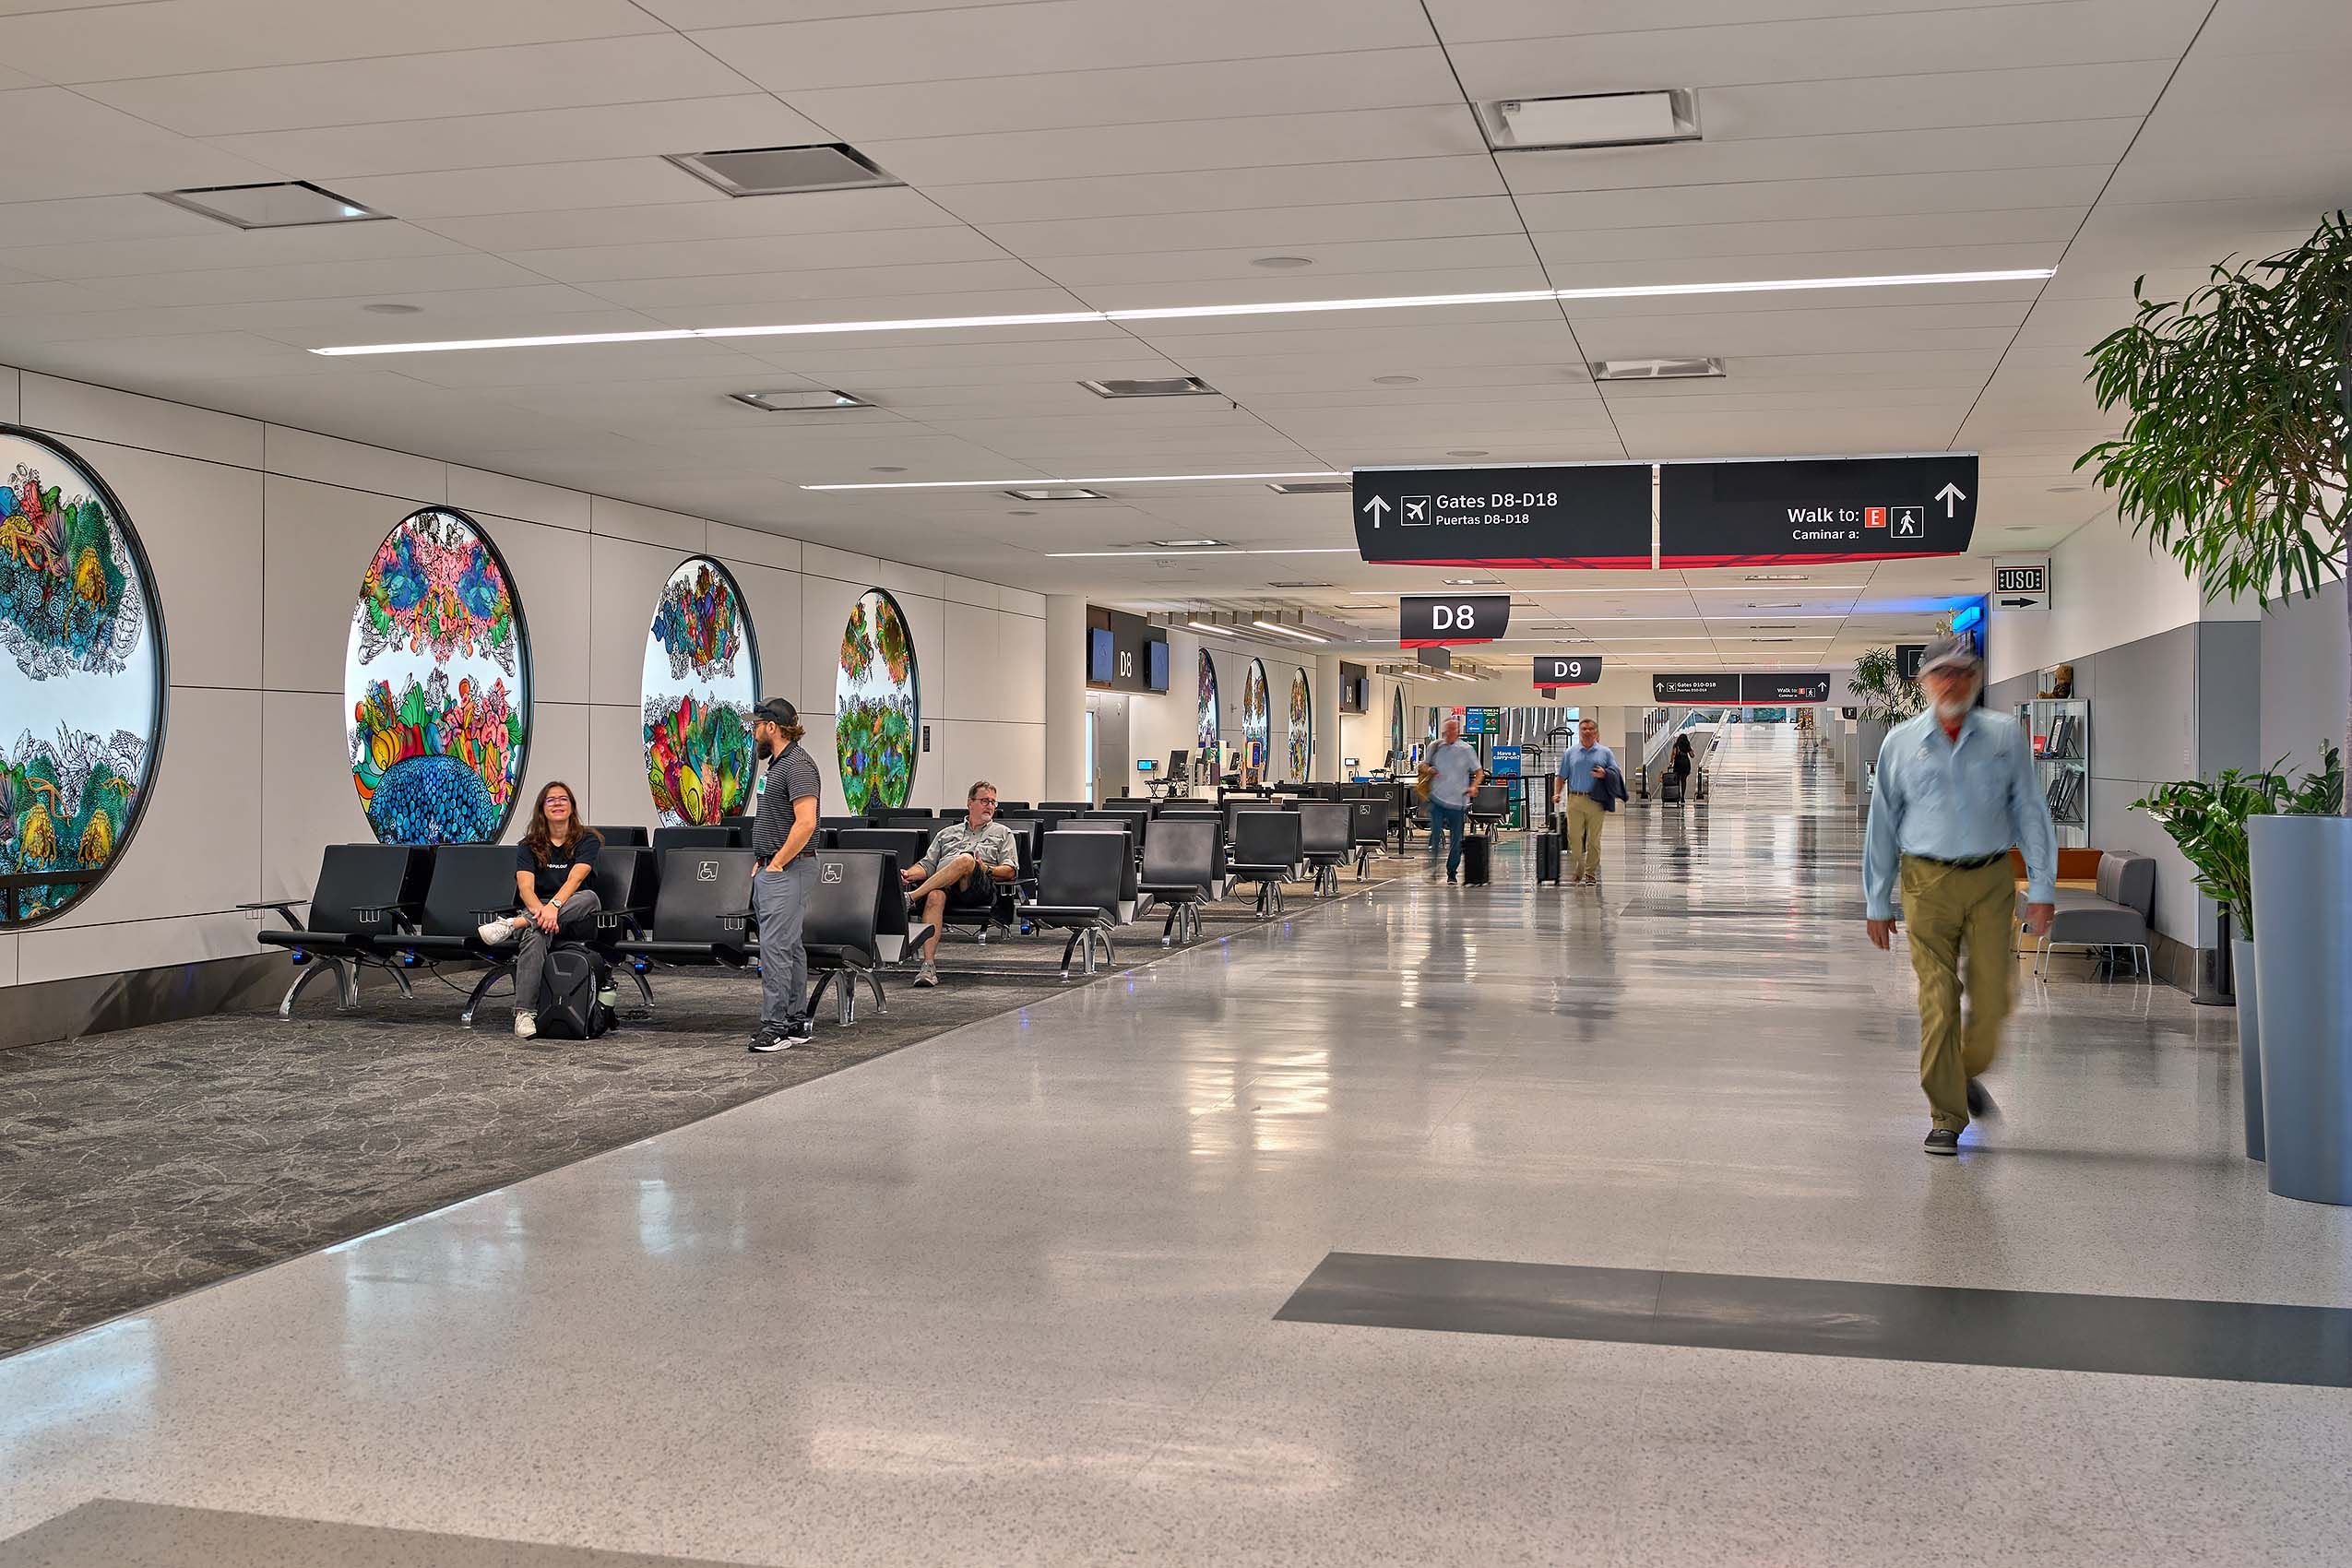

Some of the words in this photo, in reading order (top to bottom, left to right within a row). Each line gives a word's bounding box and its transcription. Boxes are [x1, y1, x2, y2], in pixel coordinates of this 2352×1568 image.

[1436, 494, 1485, 508] Gates
[1491, 493, 1558, 507] D8-D18
[1436, 516, 1480, 526] Puertas
[1484, 514, 1529, 525] D8-D18
[1788, 507, 1834, 523] Walk
[1838, 509, 1859, 522] to:
[1871, 509, 1880, 526] E
[1792, 529, 1845, 540] Caminar
[1847, 530, 1859, 540] a:
[2006, 571, 2034, 588] USO
[1432, 604, 1475, 630] D8
[1120, 650, 1133, 678] D8
[1554, 661, 1582, 678] D9
